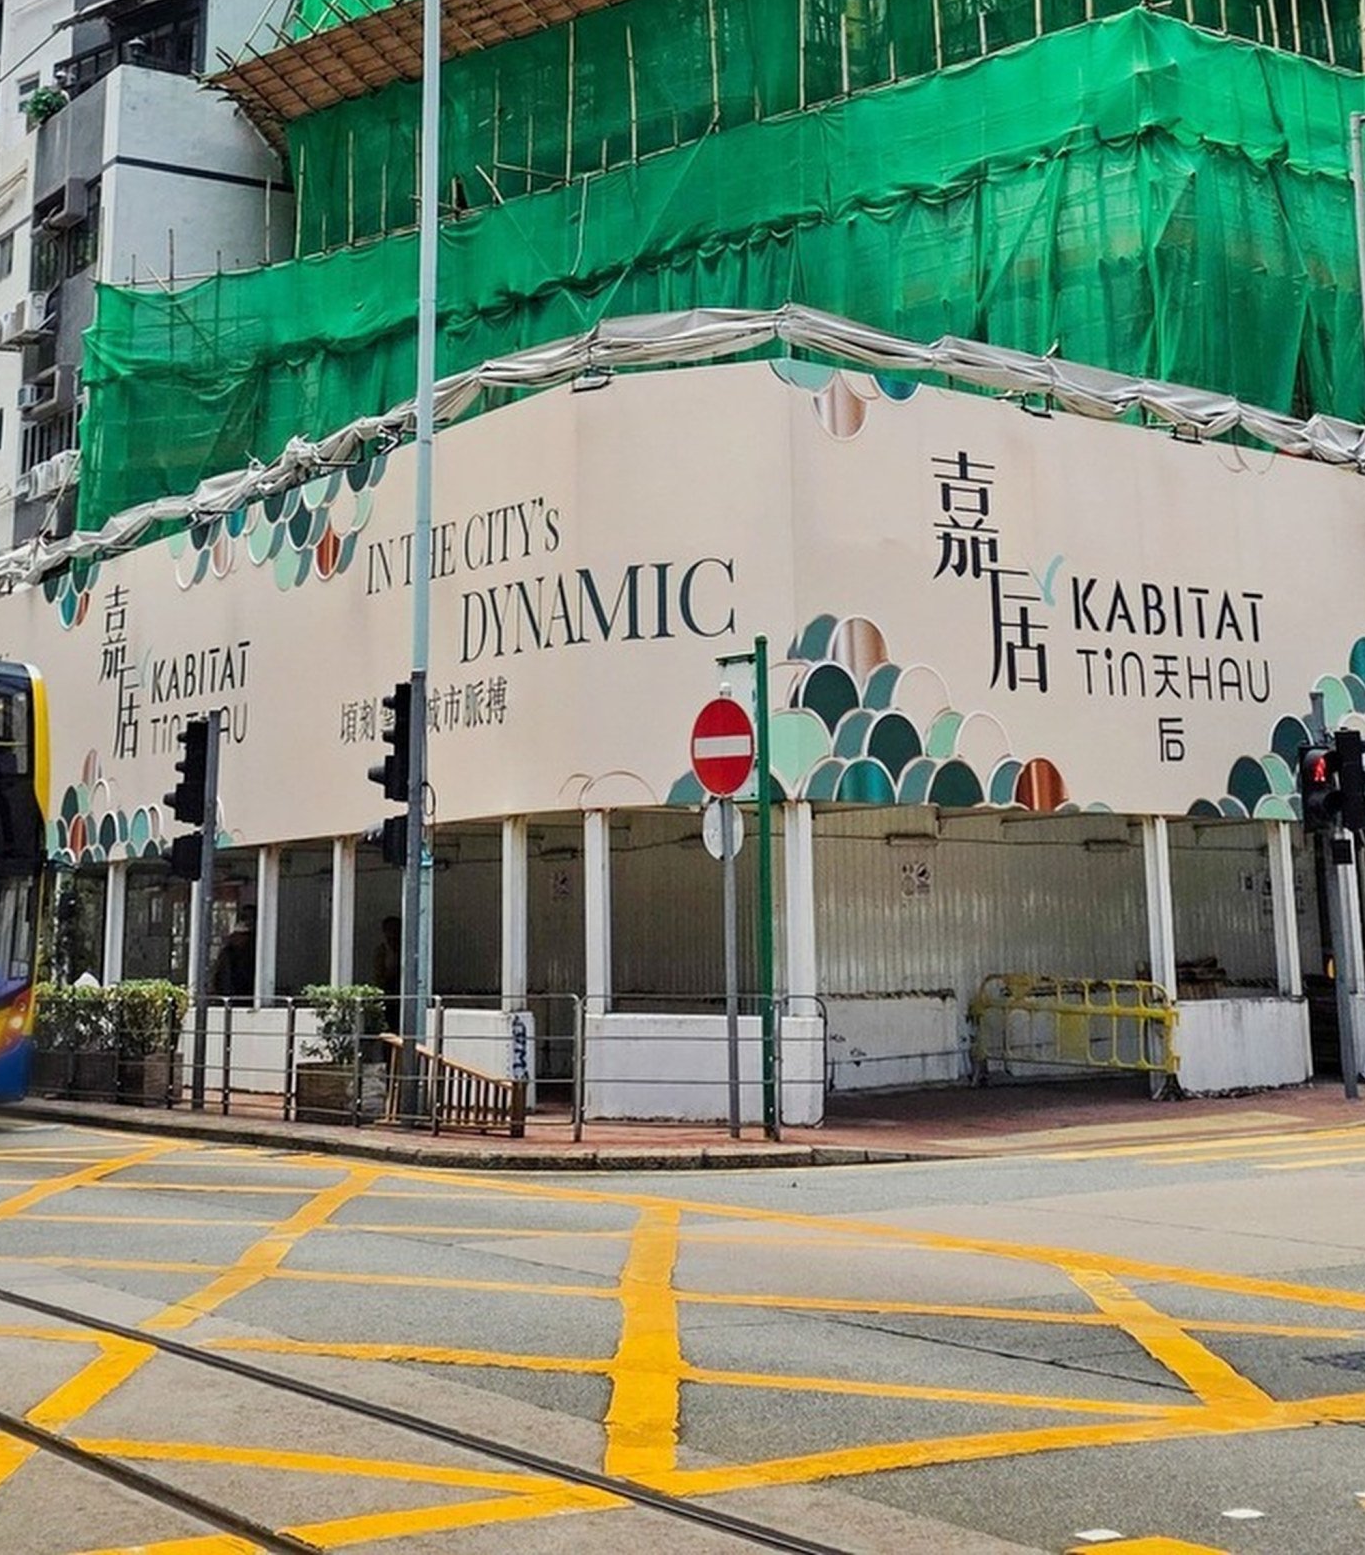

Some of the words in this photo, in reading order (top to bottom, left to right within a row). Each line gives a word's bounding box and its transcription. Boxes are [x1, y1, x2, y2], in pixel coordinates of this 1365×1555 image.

[366, 539, 397, 597] IN
[459, 556, 737, 665] DYNAMIC
[1071, 575, 1265, 644] KABITAT
[150, 640, 251, 705] KABITAT
